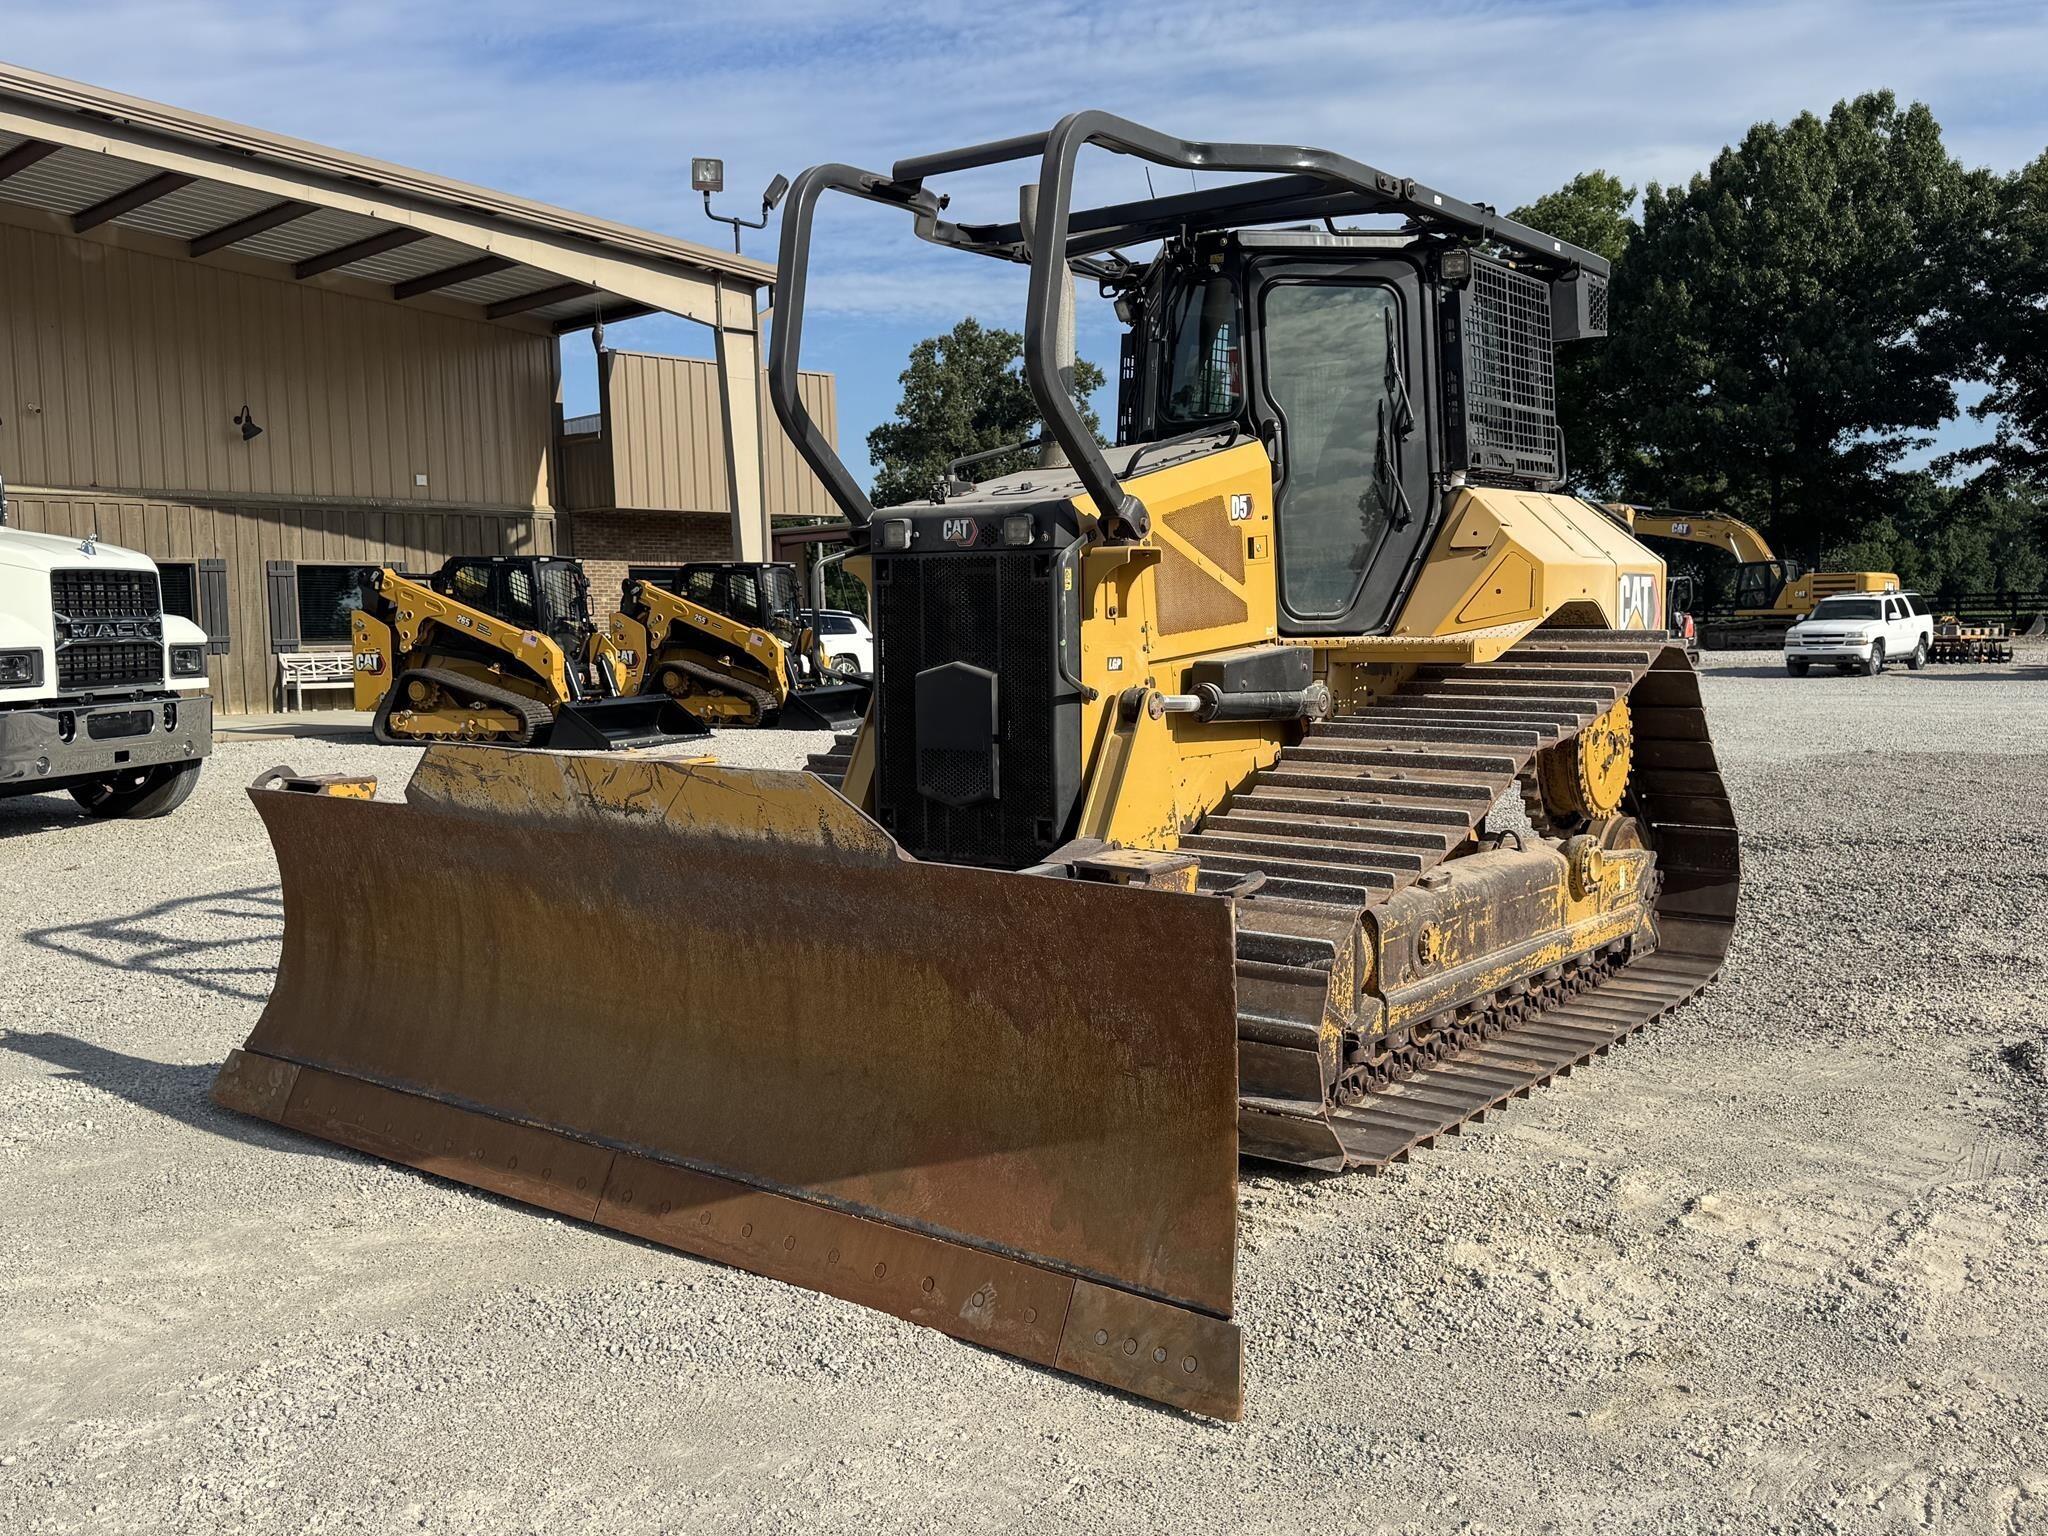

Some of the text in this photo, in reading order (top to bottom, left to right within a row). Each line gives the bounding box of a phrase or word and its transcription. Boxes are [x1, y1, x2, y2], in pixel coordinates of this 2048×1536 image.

[1231, 495, 1247, 520] D5
[943, 519, 969, 540] CAT
[1672, 522, 1688, 534] CAT
[1620, 575, 1652, 630] CAT
[456, 614, 471, 627] 265
[355, 652, 379, 672] CAT
[1109, 658, 1121, 670] LGP
